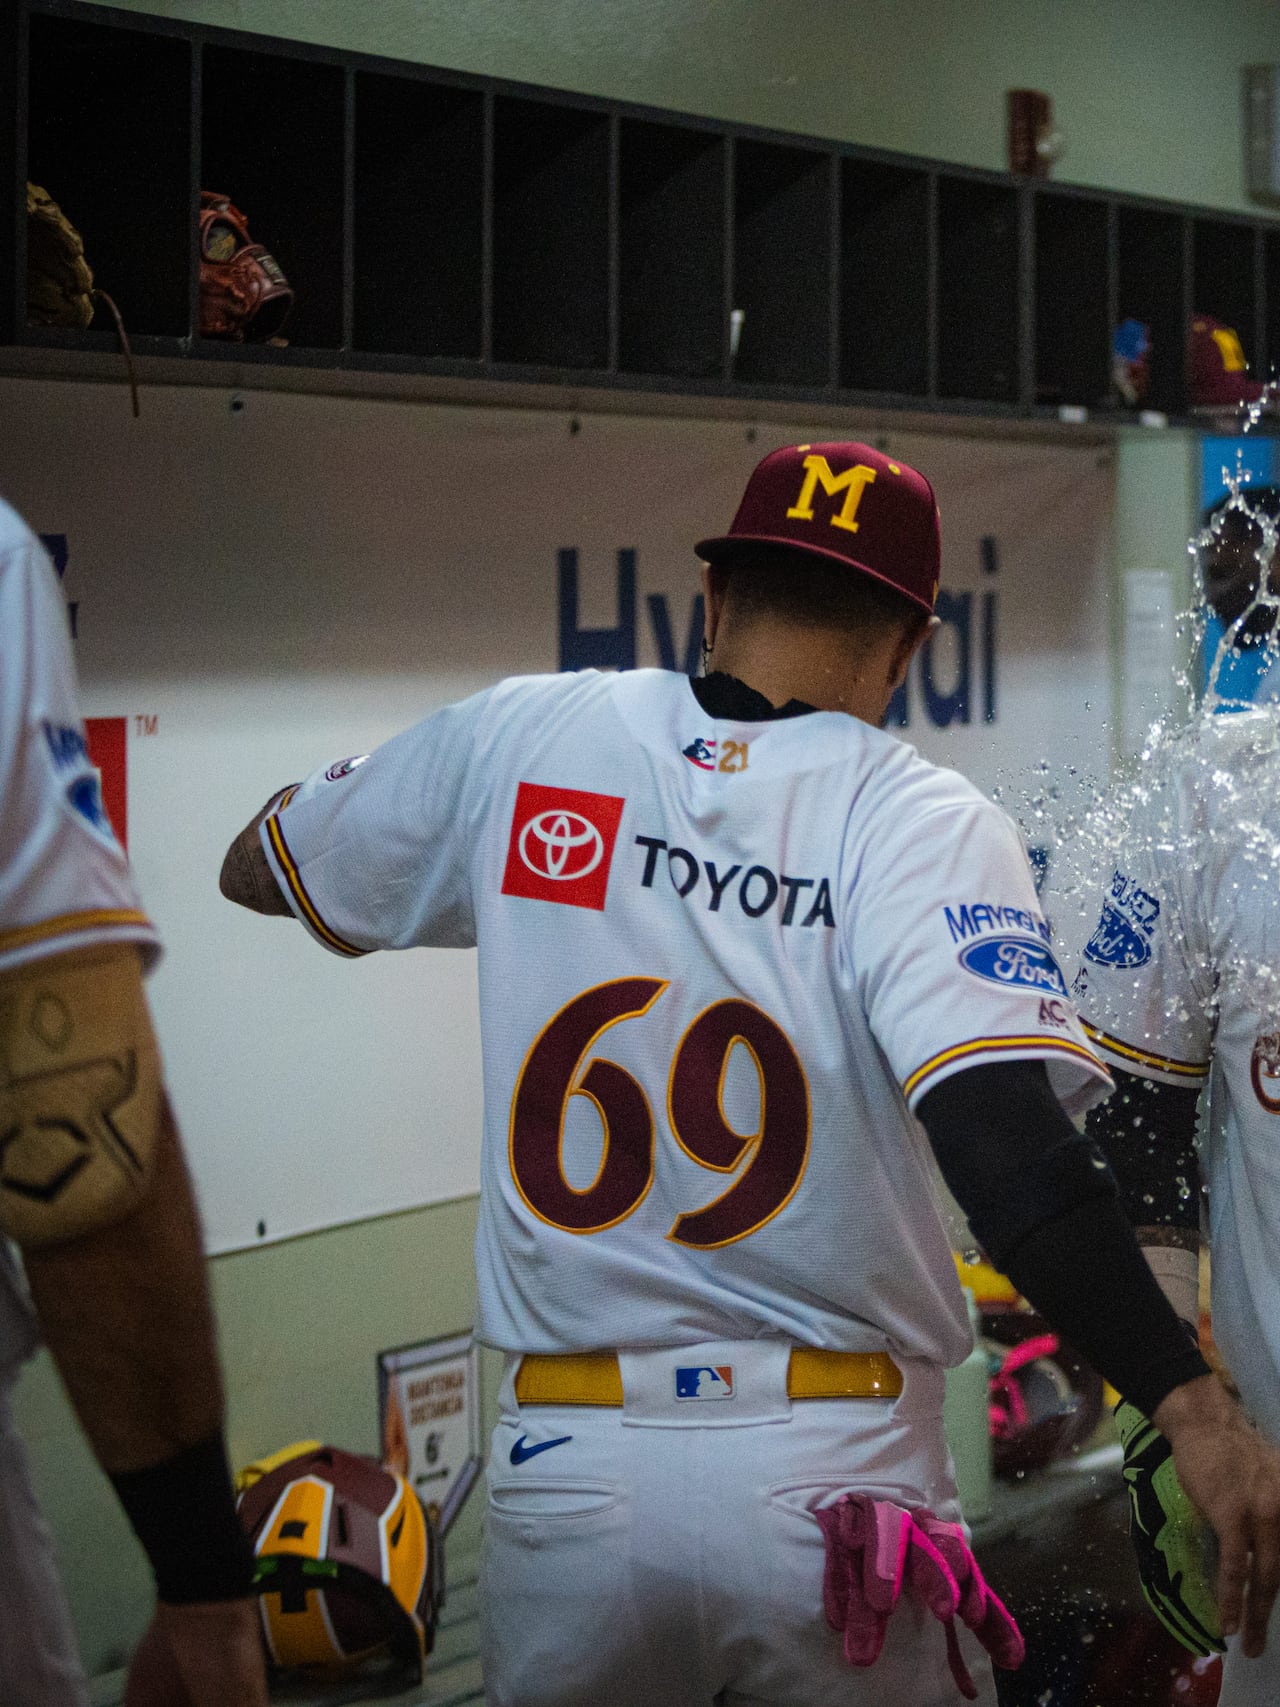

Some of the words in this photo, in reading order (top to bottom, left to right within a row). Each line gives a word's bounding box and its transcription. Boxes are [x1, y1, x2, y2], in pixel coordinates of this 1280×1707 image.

[786, 454, 877, 533] M
[718, 740, 749, 774] 21
[634, 834, 836, 929] TOYOTA
[993, 942, 1063, 993] Ford
[508, 974, 813, 1252] 69
